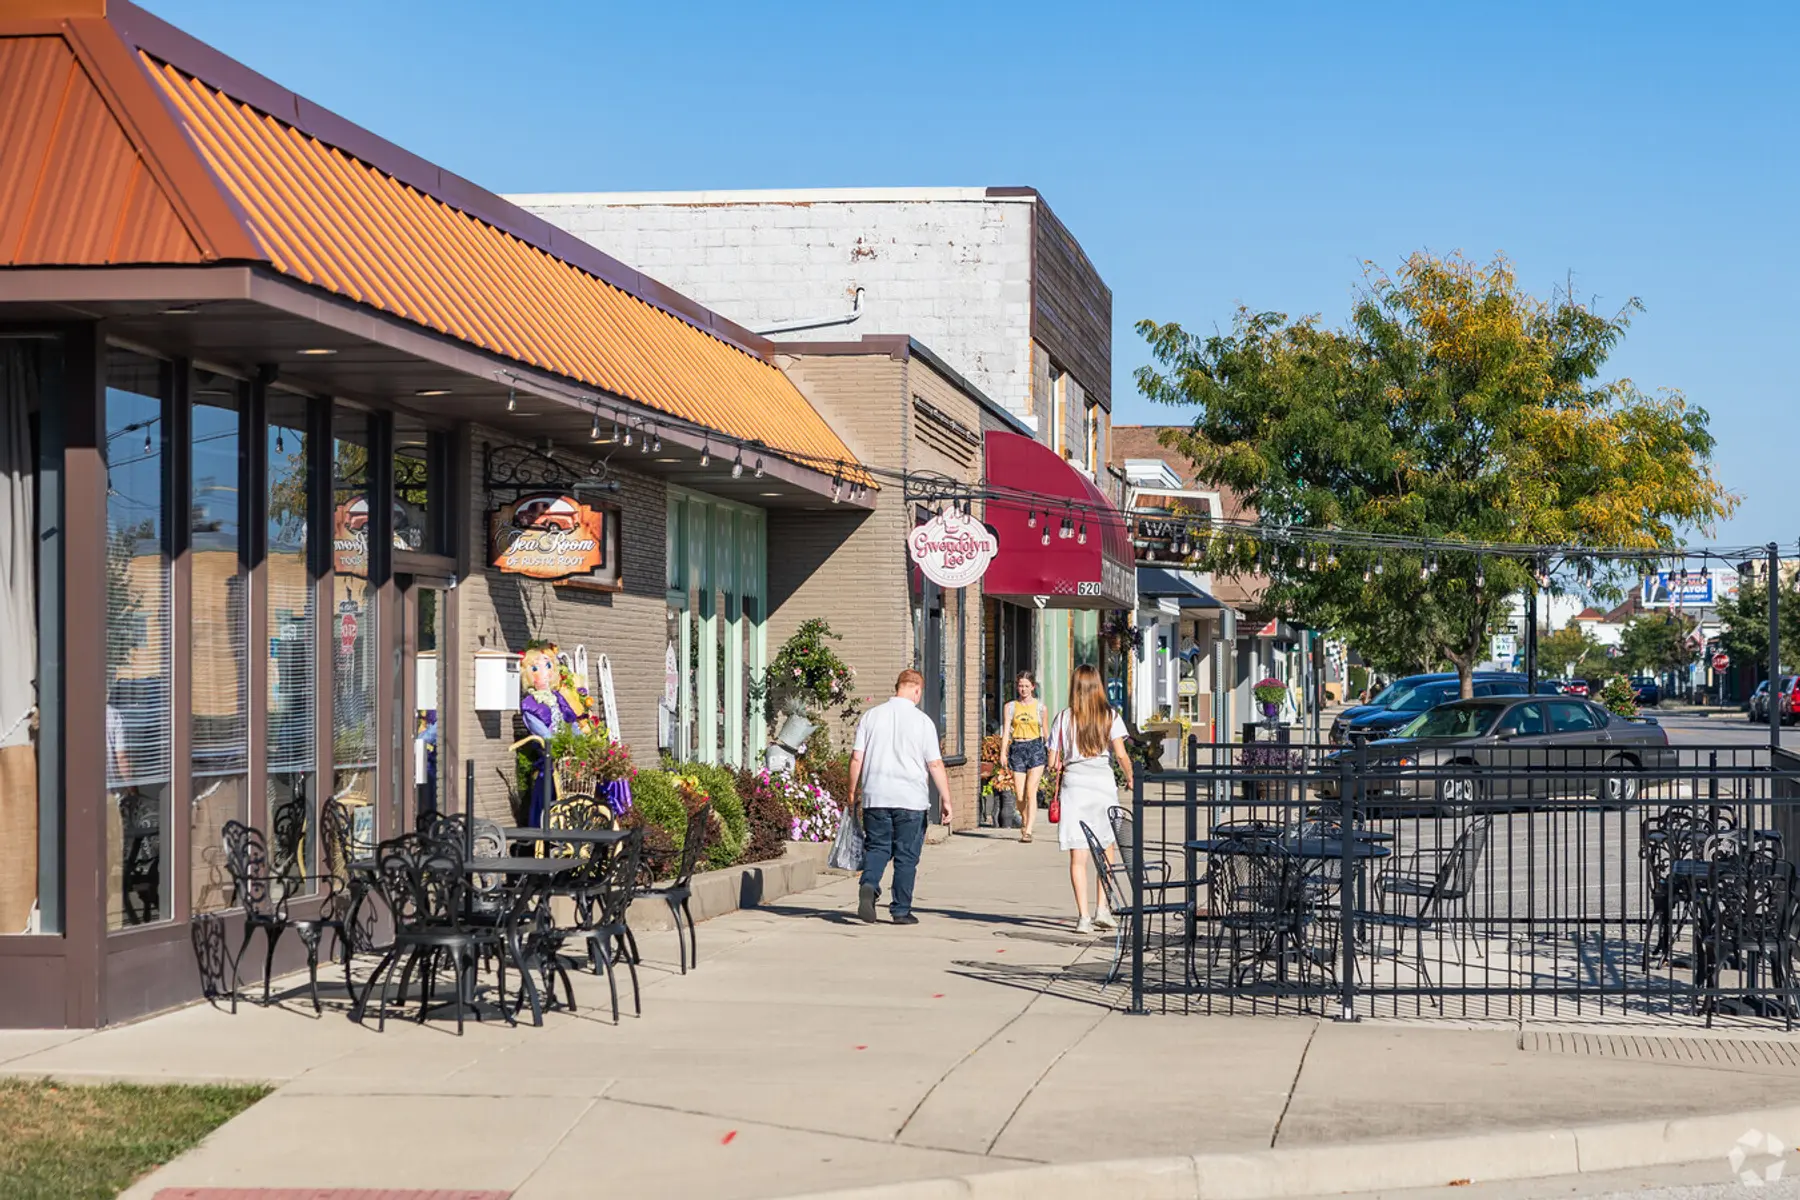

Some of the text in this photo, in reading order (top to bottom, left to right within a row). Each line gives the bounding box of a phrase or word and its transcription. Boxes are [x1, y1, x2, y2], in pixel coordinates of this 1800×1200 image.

[497, 529, 595, 555] Tea Room
[914, 532, 991, 559] Gwendolyn
[506, 556, 585, 567] OF RUSTIC ROOT
[941, 552, 964, 569] Lee
[1078, 582, 1101, 595] 620
